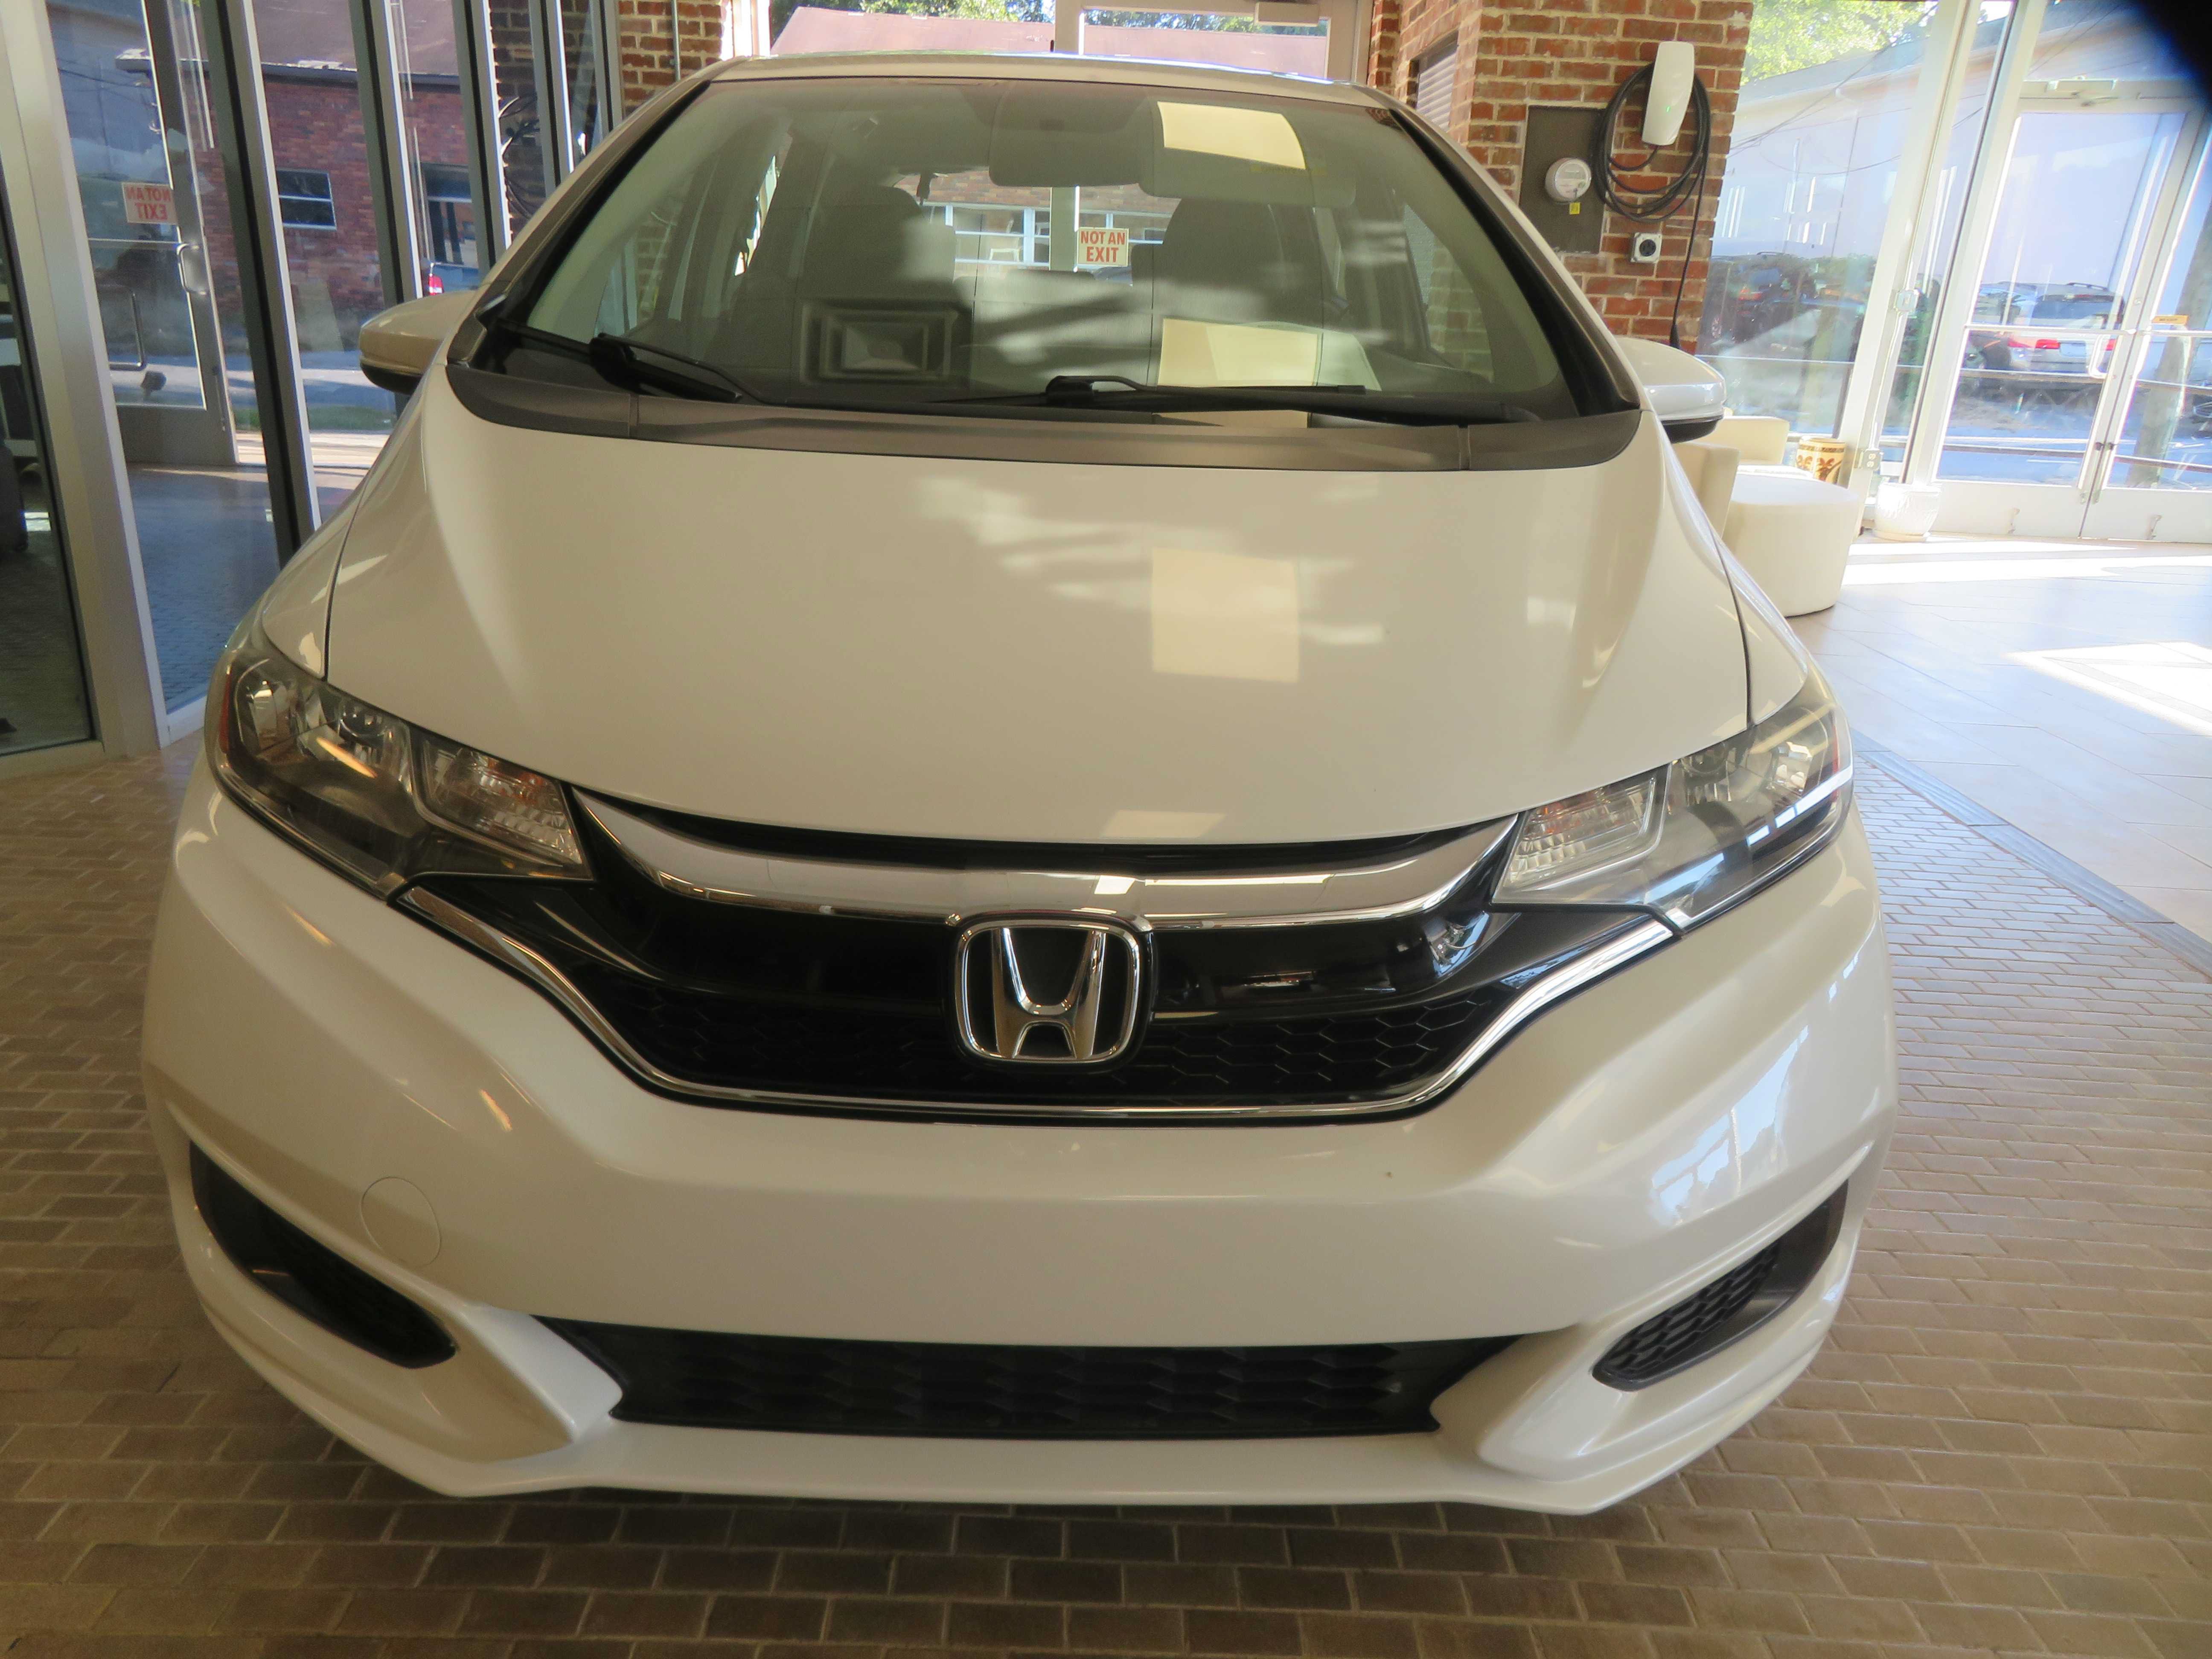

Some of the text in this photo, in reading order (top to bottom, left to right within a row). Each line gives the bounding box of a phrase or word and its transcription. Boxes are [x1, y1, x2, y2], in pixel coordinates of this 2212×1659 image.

[1081, 231, 1125, 245] NOT AN
[1086, 247, 1119, 263] EXIT
